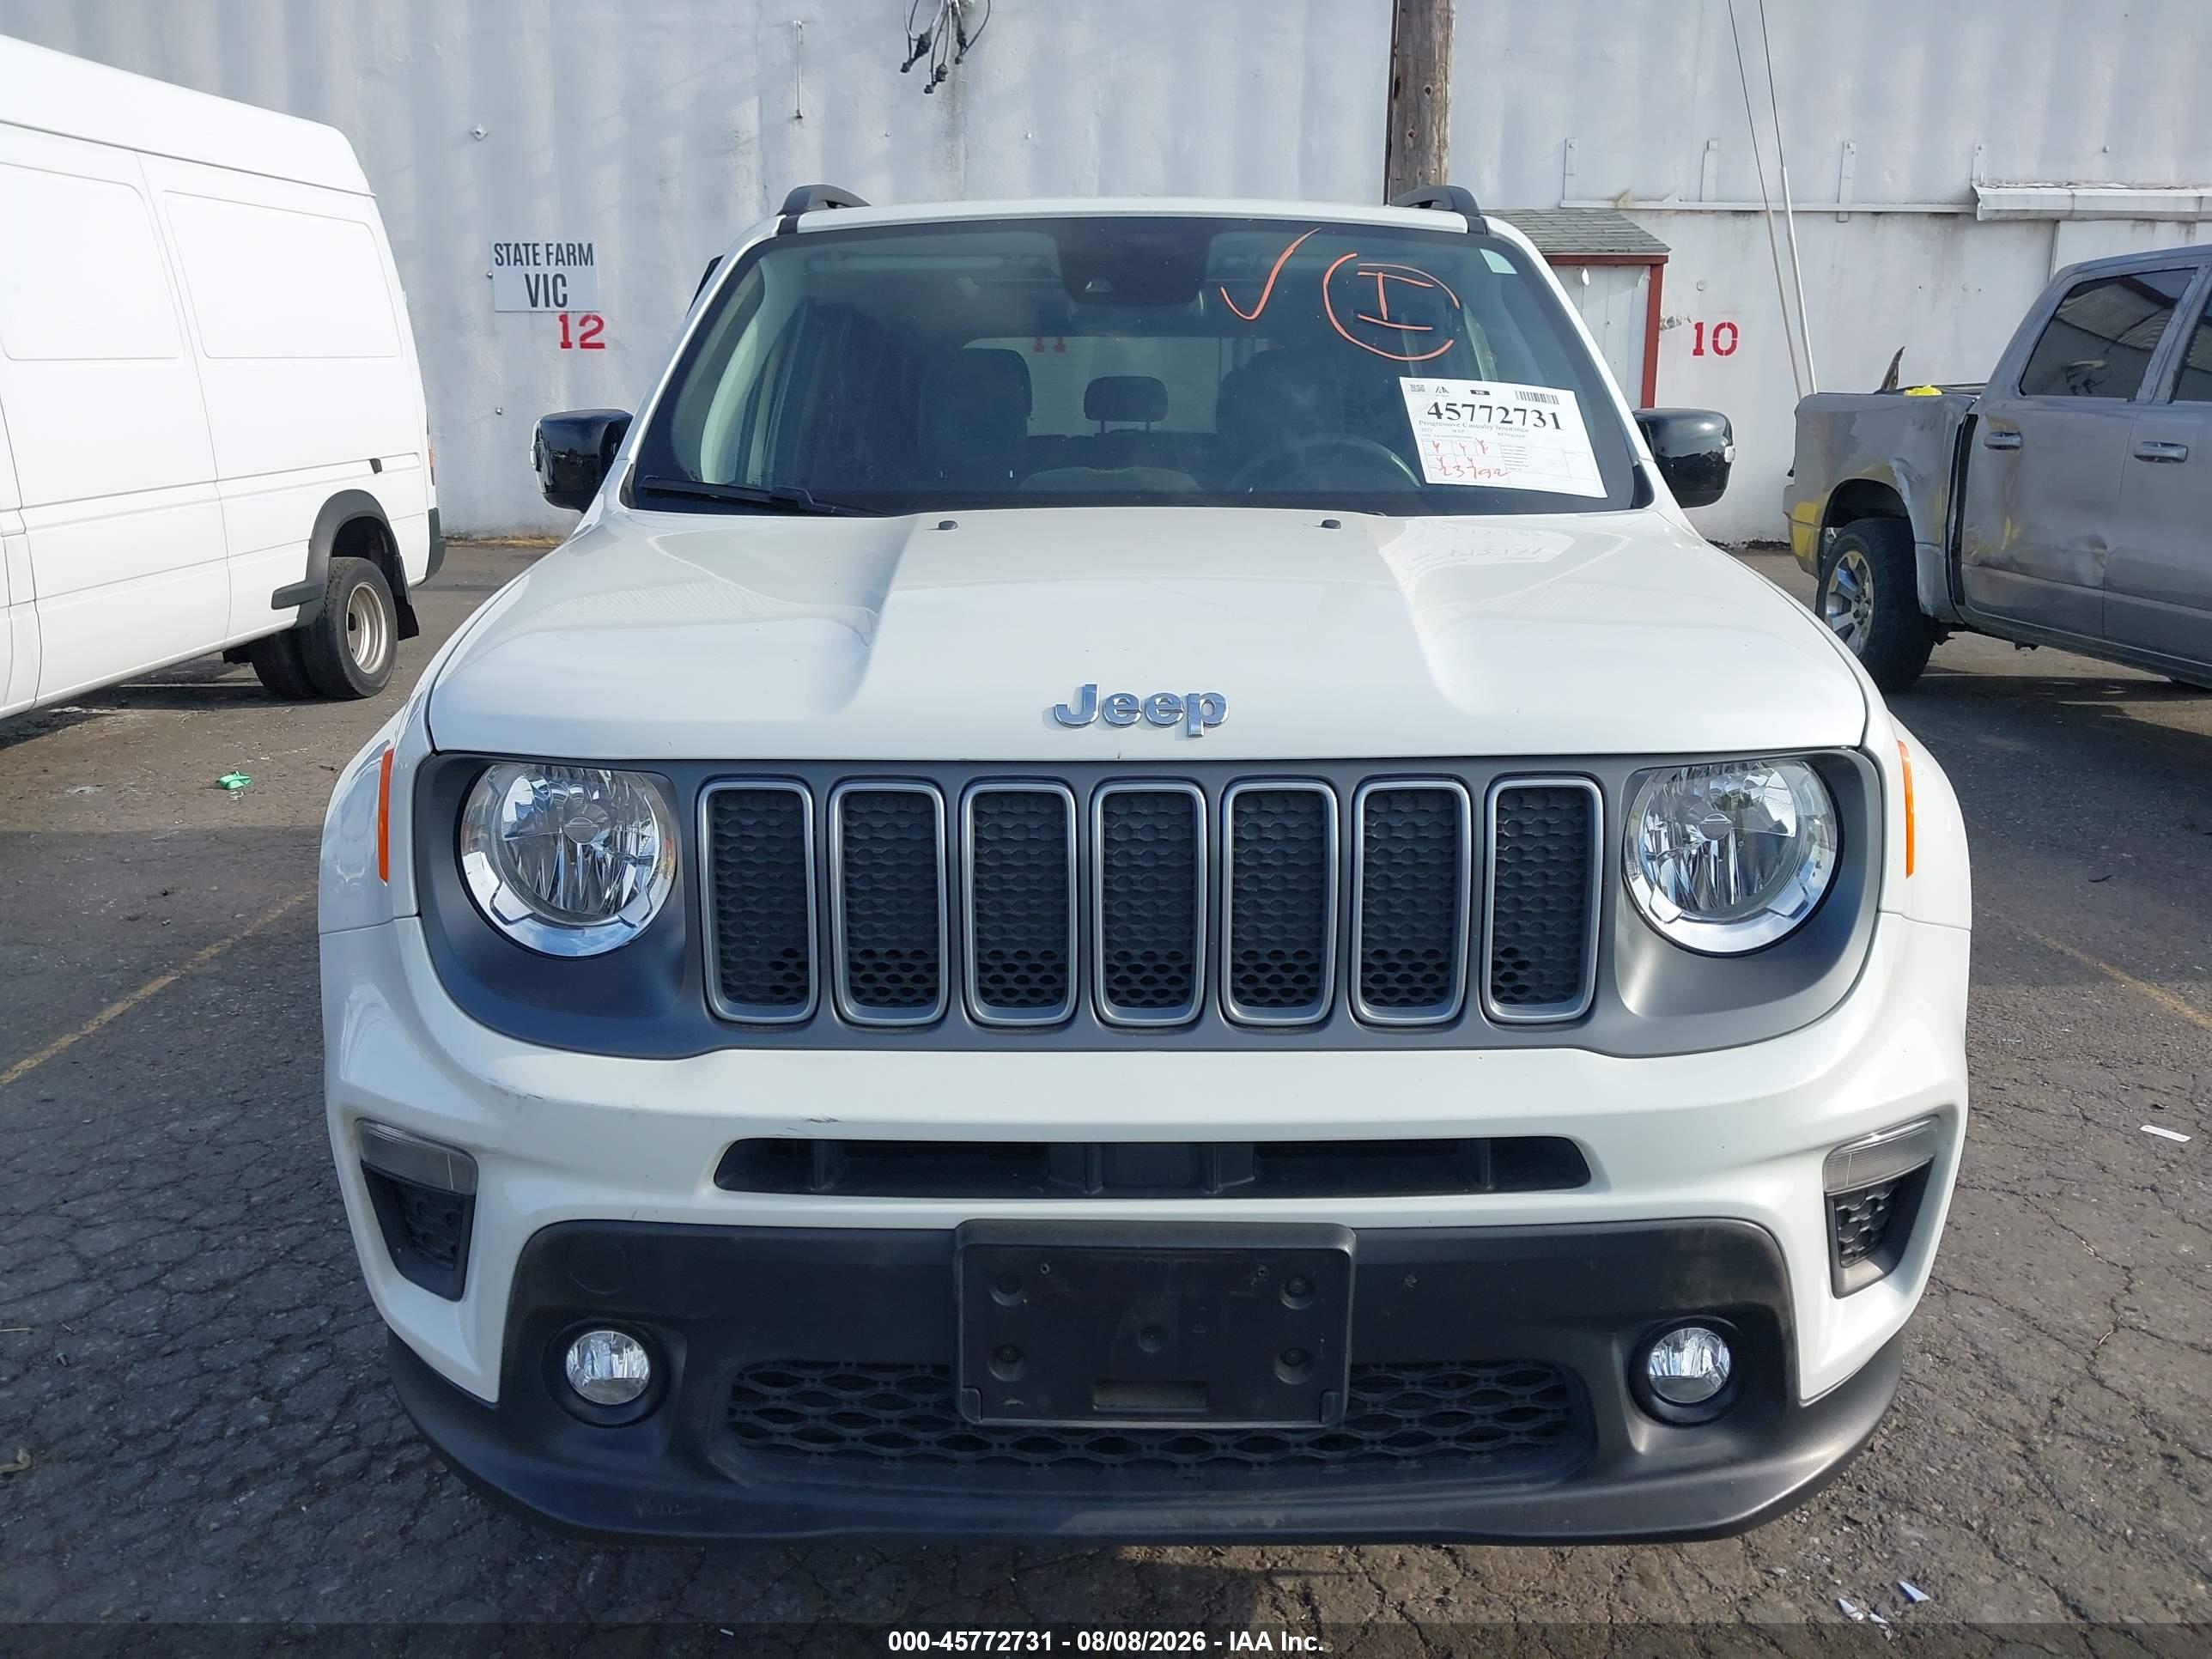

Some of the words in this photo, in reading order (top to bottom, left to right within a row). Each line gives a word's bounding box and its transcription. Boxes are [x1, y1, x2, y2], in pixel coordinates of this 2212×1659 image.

[494, 243, 542, 266] STATE
[545, 243, 594, 266] FARM
[525, 273, 568, 308] VIC
[559, 314, 605, 349] 12
[1692, 321, 1739, 356] 10
[1419, 419, 1462, 428] Progressive
[1427, 402, 1564, 430] 45772731
[1054, 684, 1230, 738] Jeep
